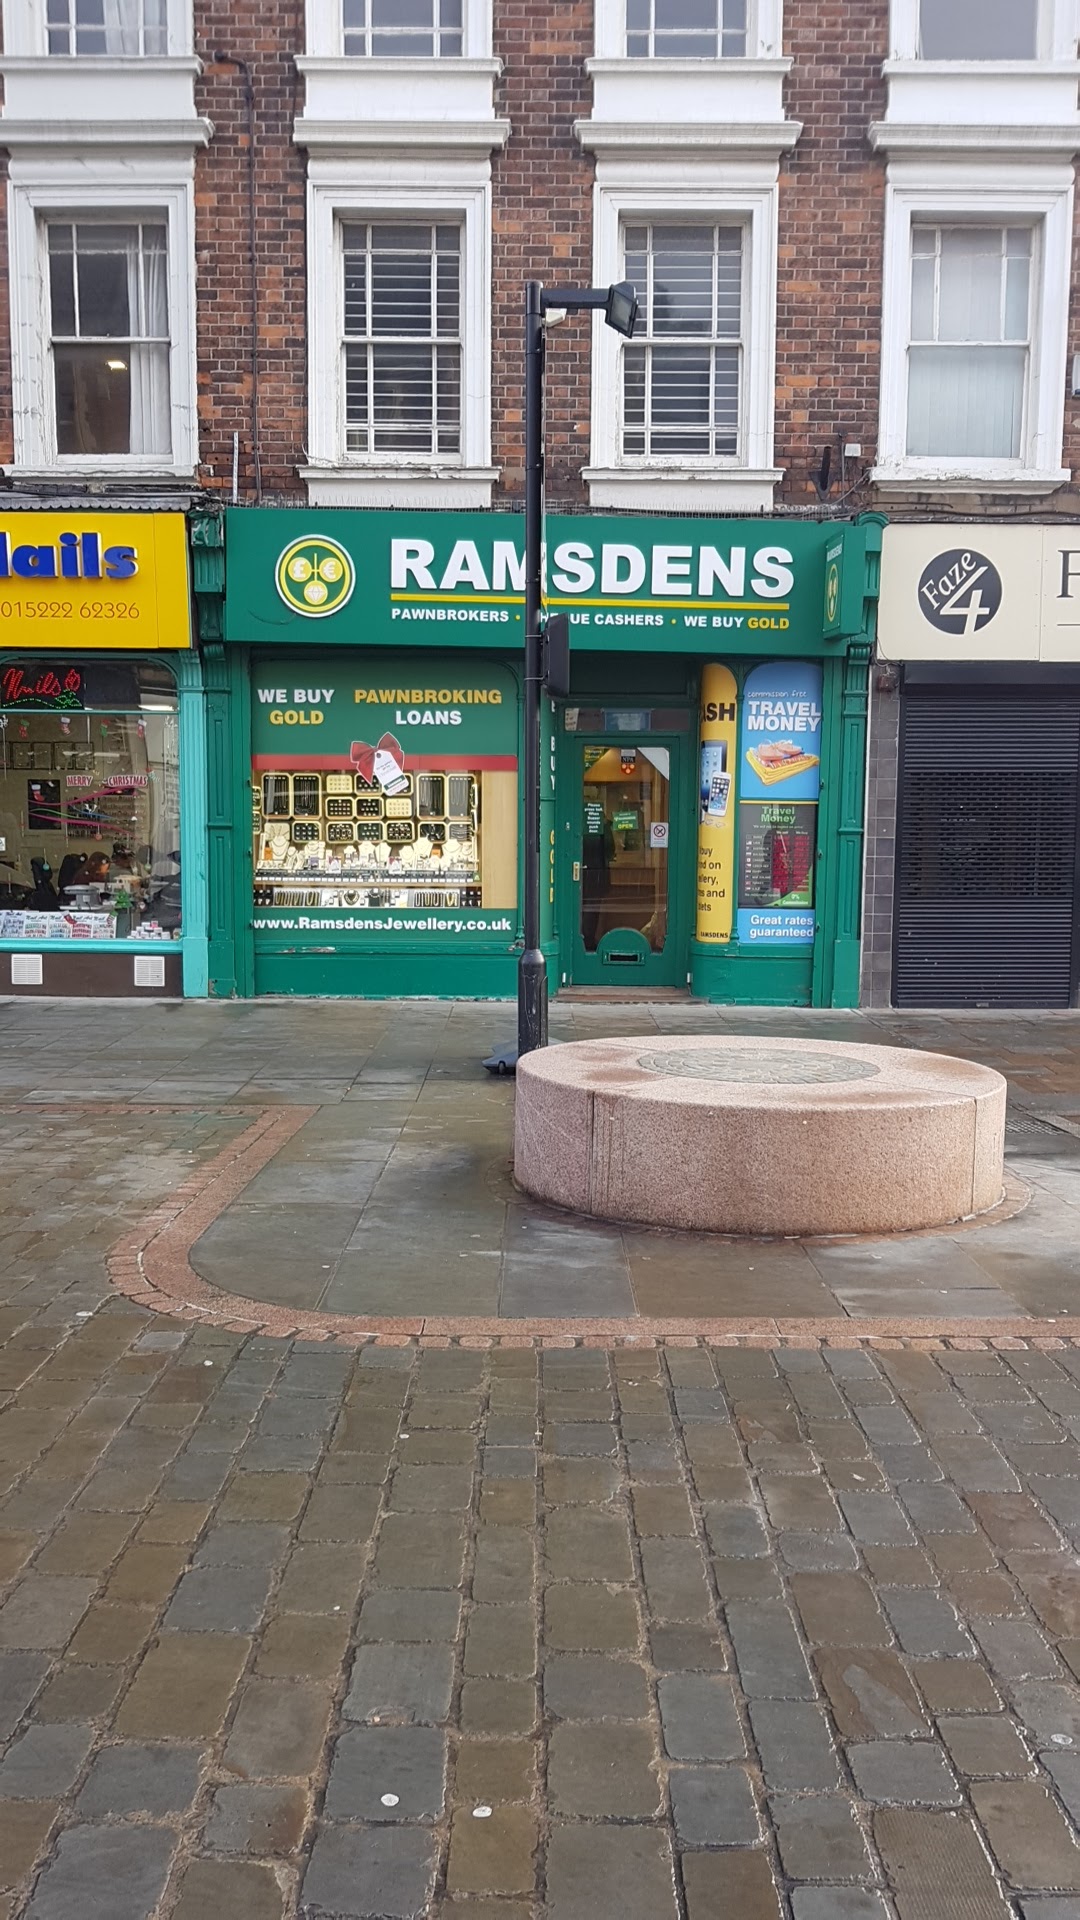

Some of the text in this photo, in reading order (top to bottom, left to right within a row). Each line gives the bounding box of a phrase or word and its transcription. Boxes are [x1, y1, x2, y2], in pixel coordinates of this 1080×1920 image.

[391, 538, 795, 598] RAMSDENS
[921, 552, 977, 610] Faze
[939, 566, 991, 635] 4
[0, 601, 140, 619] 015222 62326
[391, 608, 509, 622] PAWNBROKERS
[594, 614, 664, 627] CASHERS
[684, 615, 790, 630] WE BUY GOLD
[257, 688, 335, 704] WE BUY
[354, 689, 502, 704] PAWNBROKING
[791, 690, 807, 698] free
[748, 700, 821, 717] TRAVEL
[269, 710, 324, 725] GOLD
[395, 710, 462, 725] LOANS
[747, 715, 821, 732] MONEY
[66, 775, 148, 787] MERRY CHRISTMAS
[762, 806, 795, 815] Travel
[761, 814, 796, 824] Money
[708, 861, 721, 870] on
[706, 888, 725, 898] and
[253, 916, 512, 932] www.RamsdensJewellery.co.uk
[750, 914, 814, 925] Great rates
[749, 927, 814, 938] guaranteed
